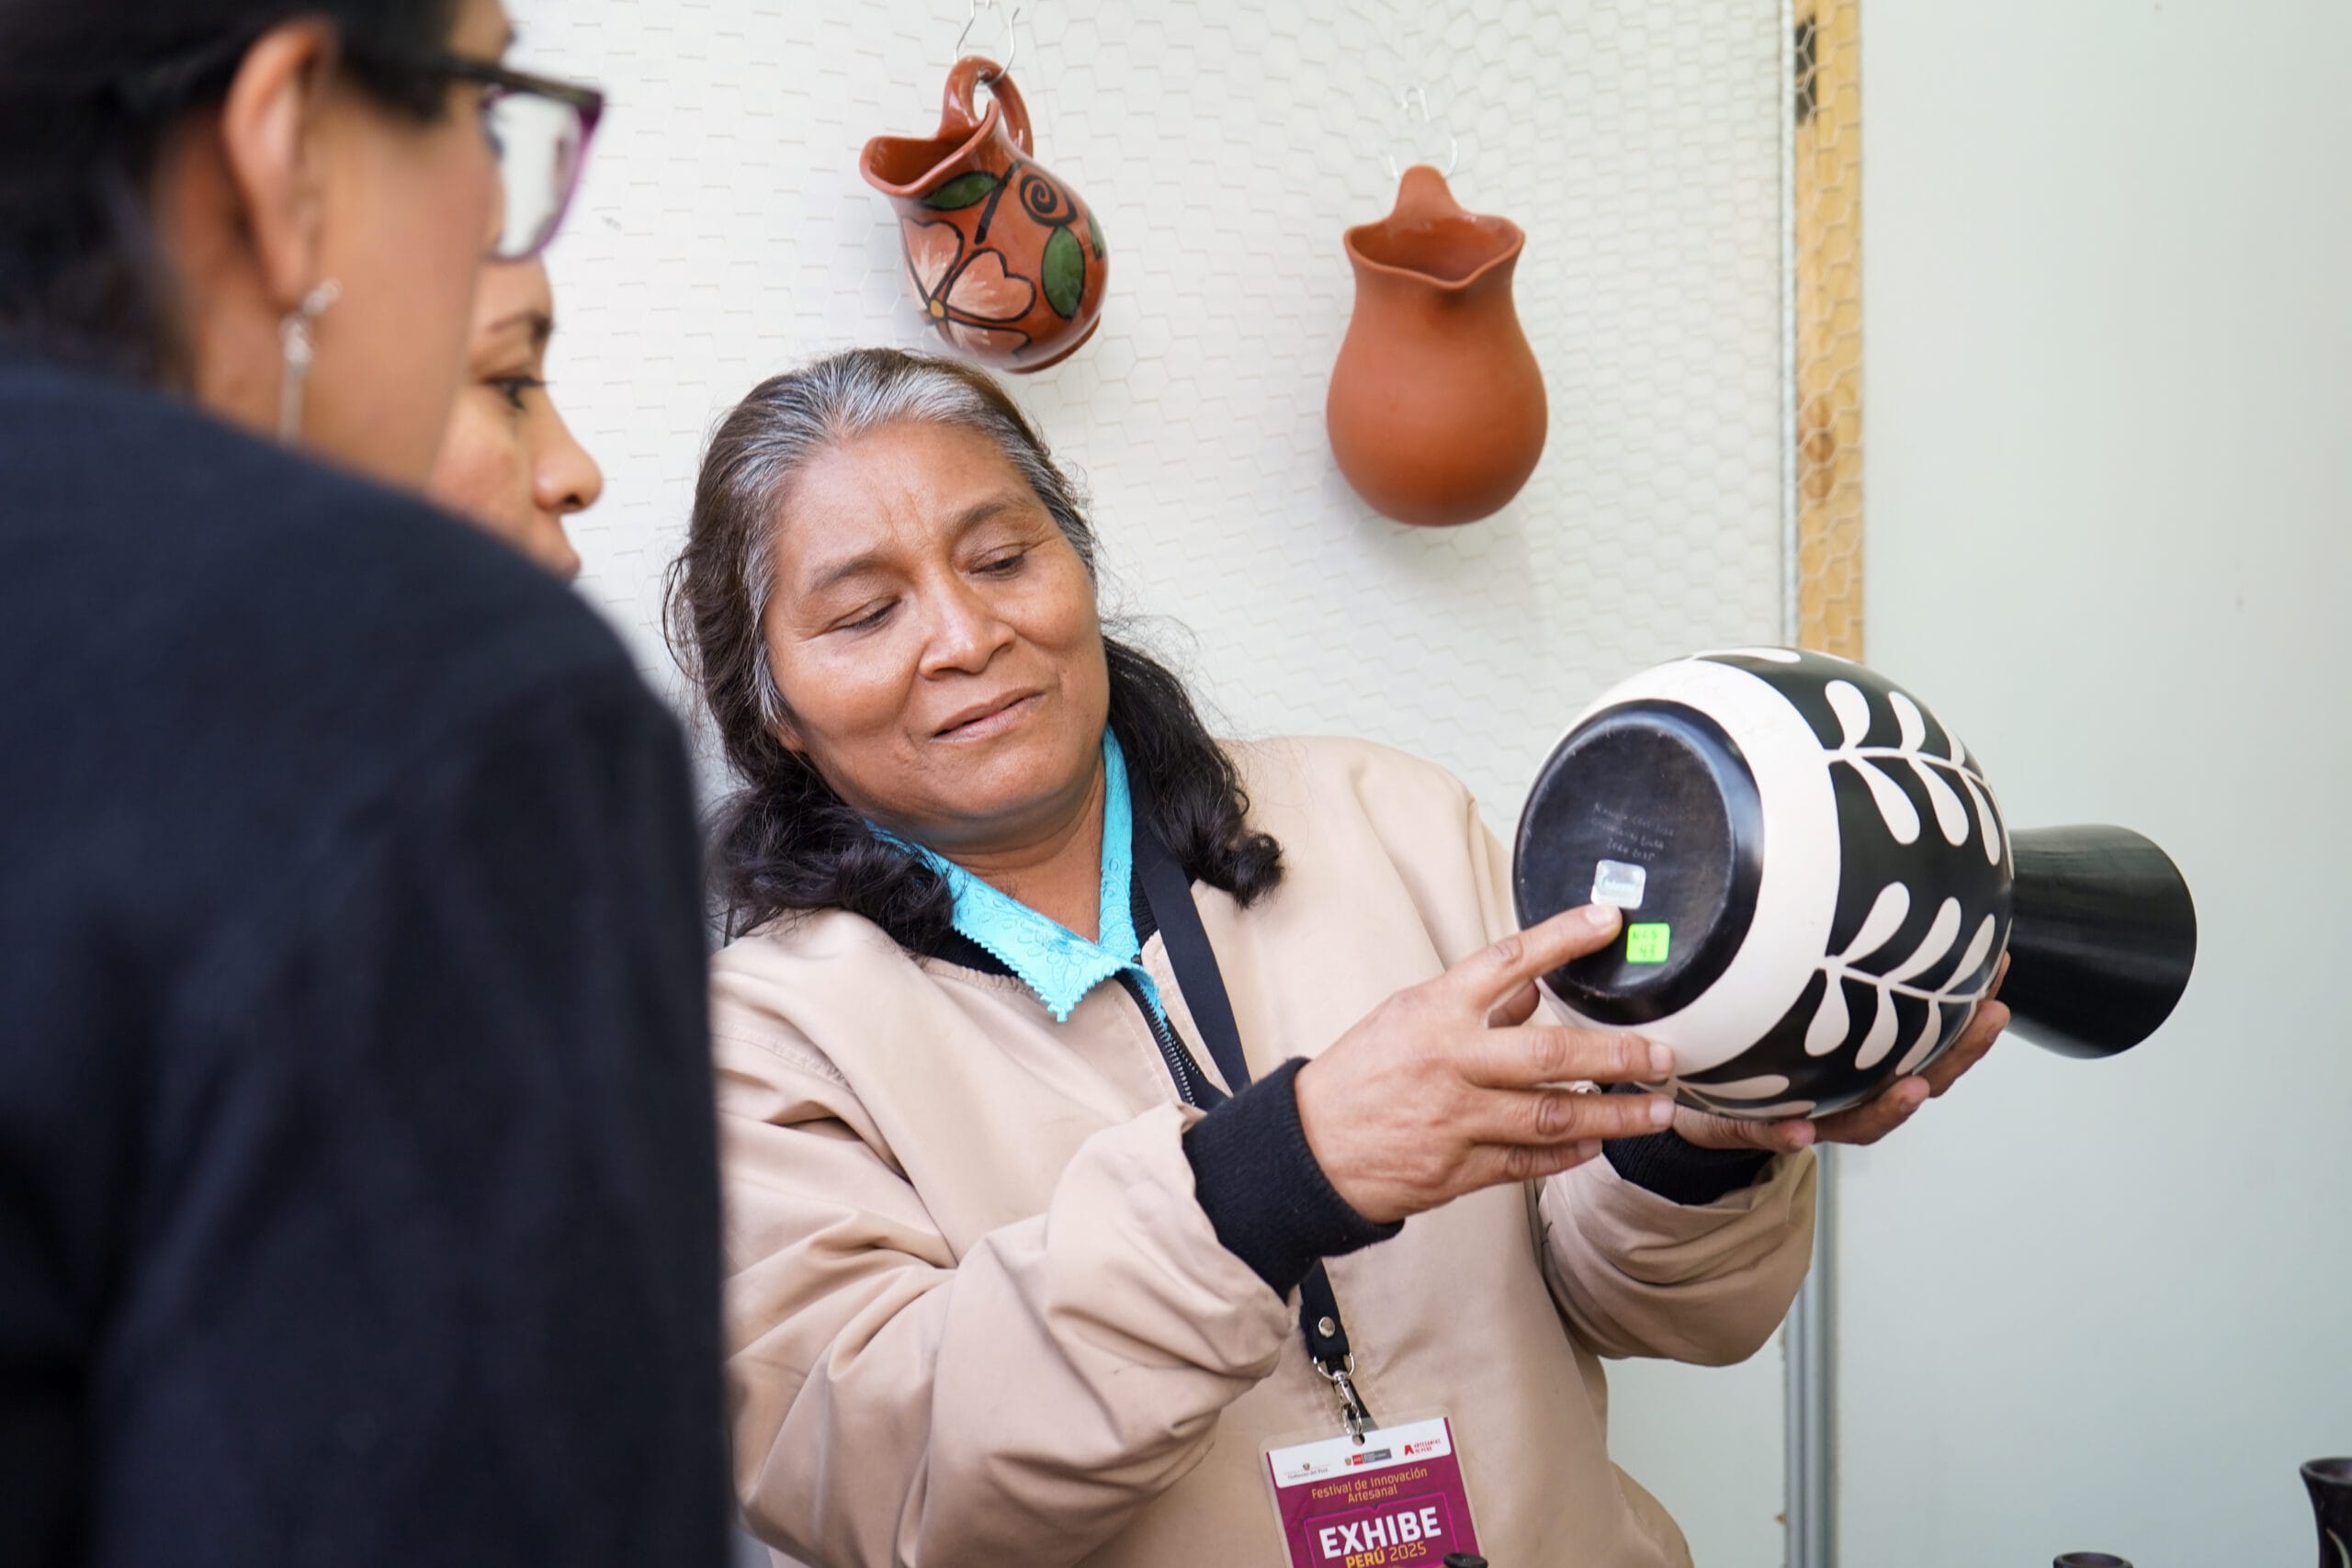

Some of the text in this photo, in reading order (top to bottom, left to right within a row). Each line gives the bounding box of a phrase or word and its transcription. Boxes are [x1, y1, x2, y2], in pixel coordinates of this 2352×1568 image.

[1312, 1467, 1428, 1499] Festival de Innovación
[1348, 1484, 1397, 1504] Artesanal
[1319, 1506, 1442, 1559] EXHIBE
[1346, 1541, 1426, 1568] PERÚ 2025
